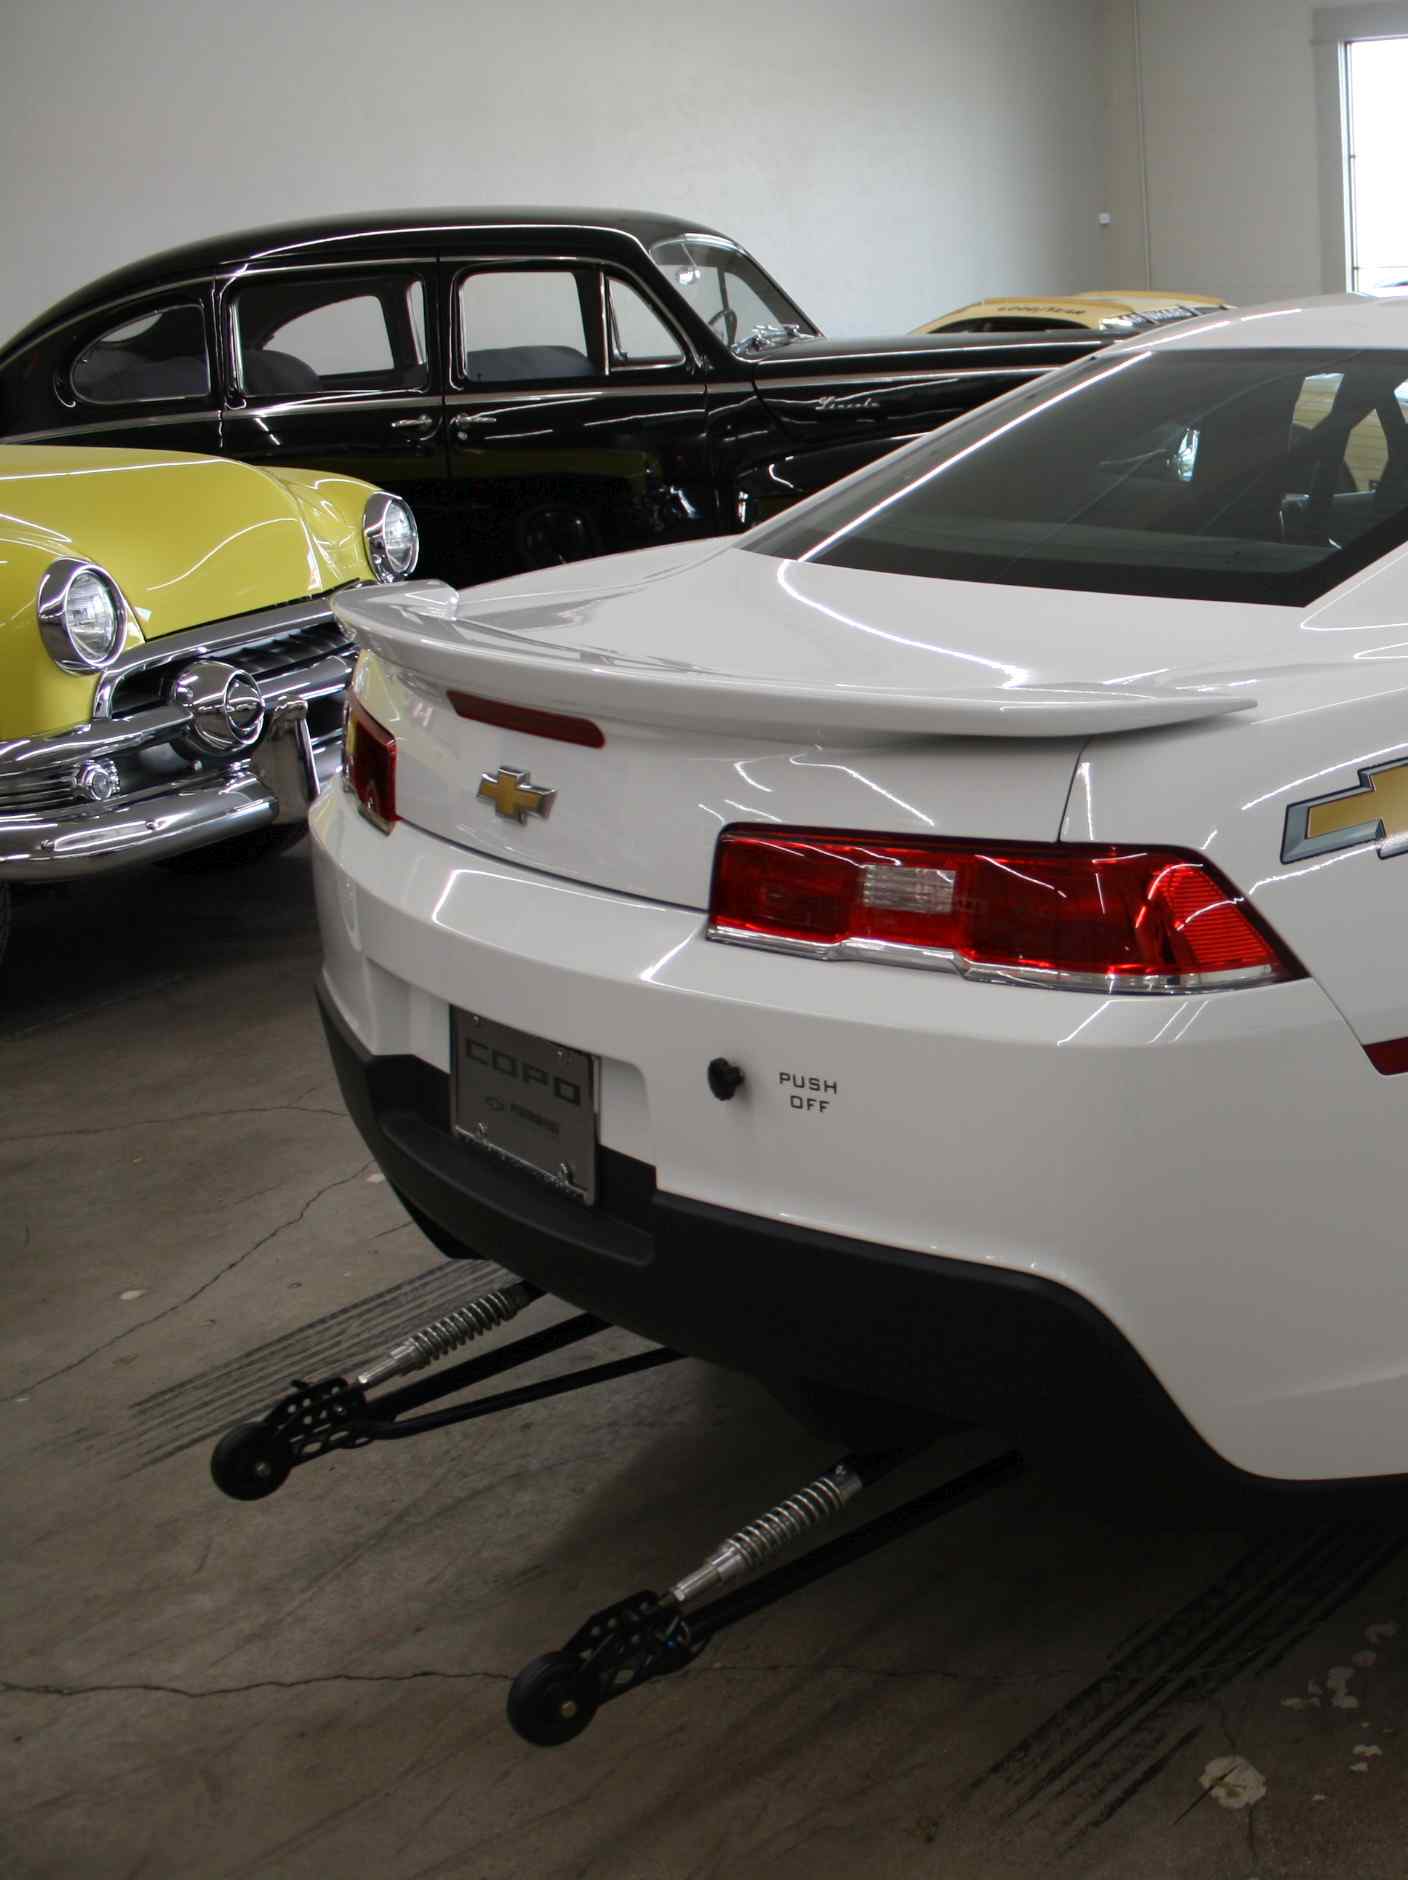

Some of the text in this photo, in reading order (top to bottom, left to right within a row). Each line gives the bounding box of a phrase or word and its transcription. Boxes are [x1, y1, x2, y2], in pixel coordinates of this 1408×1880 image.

[464, 1038, 581, 1106] COPO
[779, 1072, 837, 1095] PUSH
[790, 1095, 830, 1113] OFF
